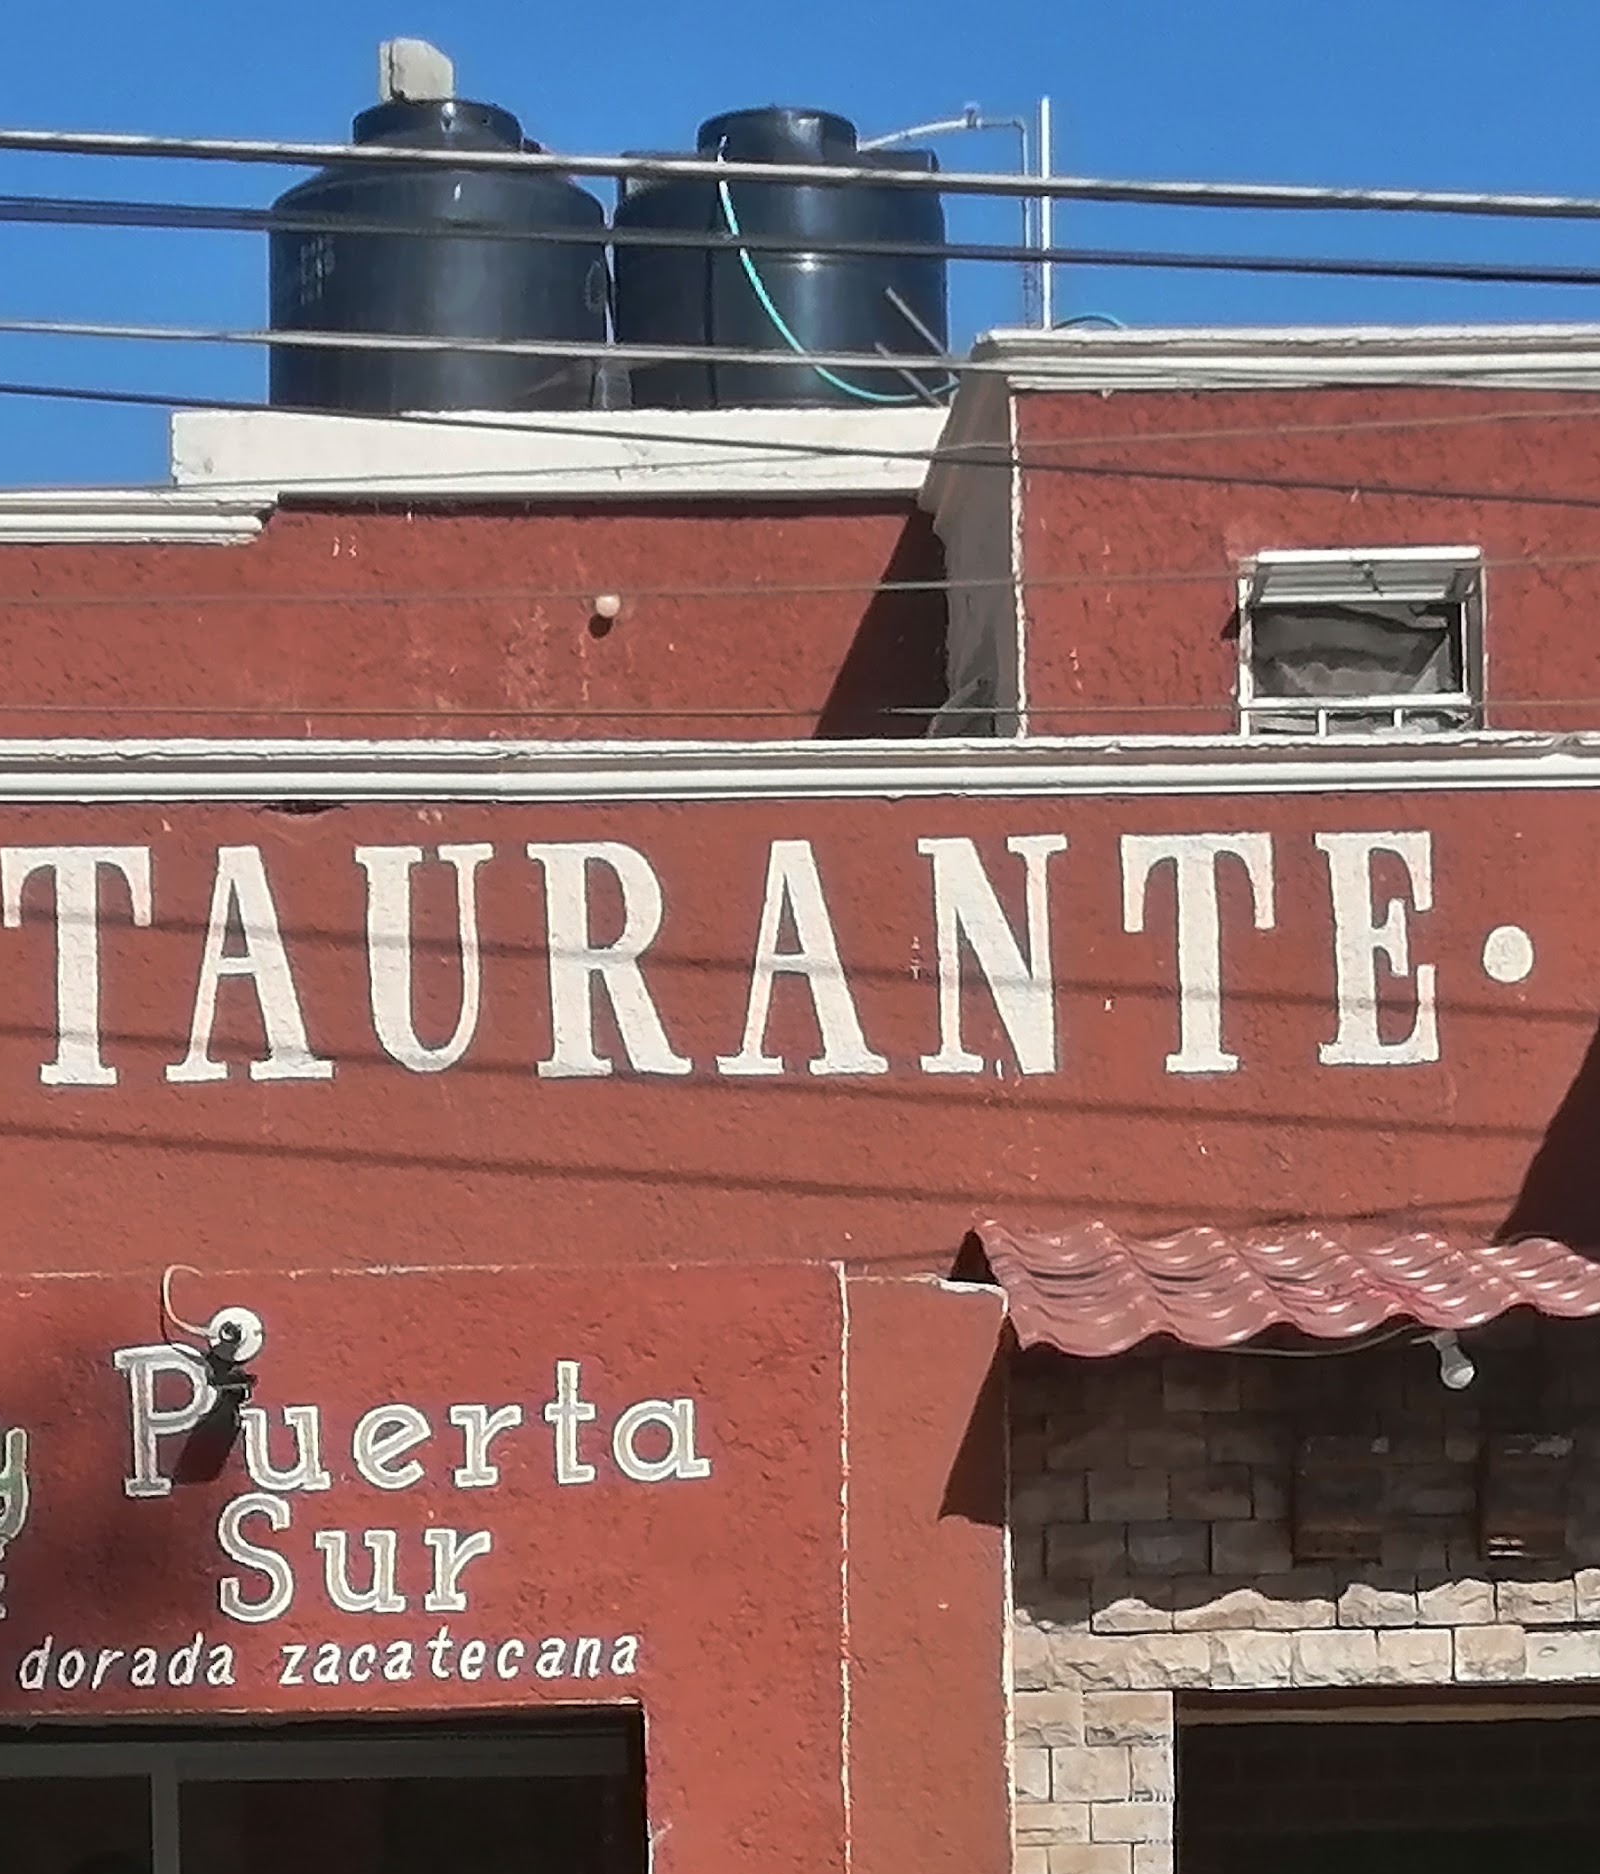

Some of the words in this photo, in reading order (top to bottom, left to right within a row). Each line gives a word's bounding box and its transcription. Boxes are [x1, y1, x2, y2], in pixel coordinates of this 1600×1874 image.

[113, 1343, 713, 1500] Puerta
[215, 1493, 497, 1623] Sur
[18, 1634, 236, 1690] dorada
[278, 1628, 641, 1686] zacatecana
